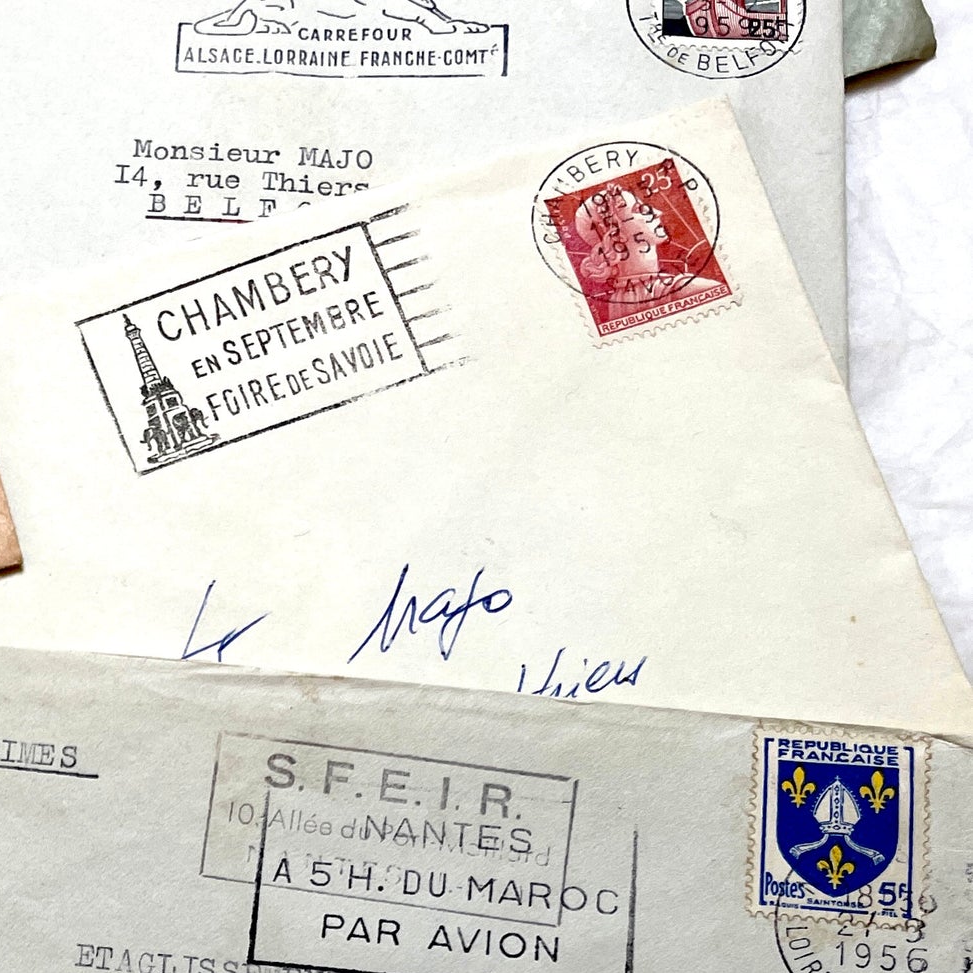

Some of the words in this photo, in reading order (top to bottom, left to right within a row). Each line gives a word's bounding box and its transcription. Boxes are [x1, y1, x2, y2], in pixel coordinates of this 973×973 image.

[298, 26, 412, 42] CARREFOUR
[132, 138, 281, 165] Monsieur
[298, 147, 374, 170] MAJO
[187, 173, 241, 190] rue
[261, 171, 370, 196] Thiers
[157, 244, 353, 342] CHAMBERY
[191, 353, 222, 379] EN
[221, 290, 385, 366] SEPTEMBRE
[601, 306, 667, 333] REPUBLIQUE
[206, 372, 286, 422] FOIRE
[286, 373, 312, 397] DE
[311, 332, 404, 385] SAVOIE
[777, 738, 899, 756] REPUBLIQUE
[268, 809, 333, 835] Allée
[364, 815, 533, 854] NANTES
[271, 857, 293, 884] A
[403, 869, 448, 898] DU
[467, 875, 620, 916] MAROC
[764, 872, 806, 900] Postes
[320, 913, 401, 947] PAR
[427, 925, 561, 963] AVION
[835, 940, 929, 973] 1956
